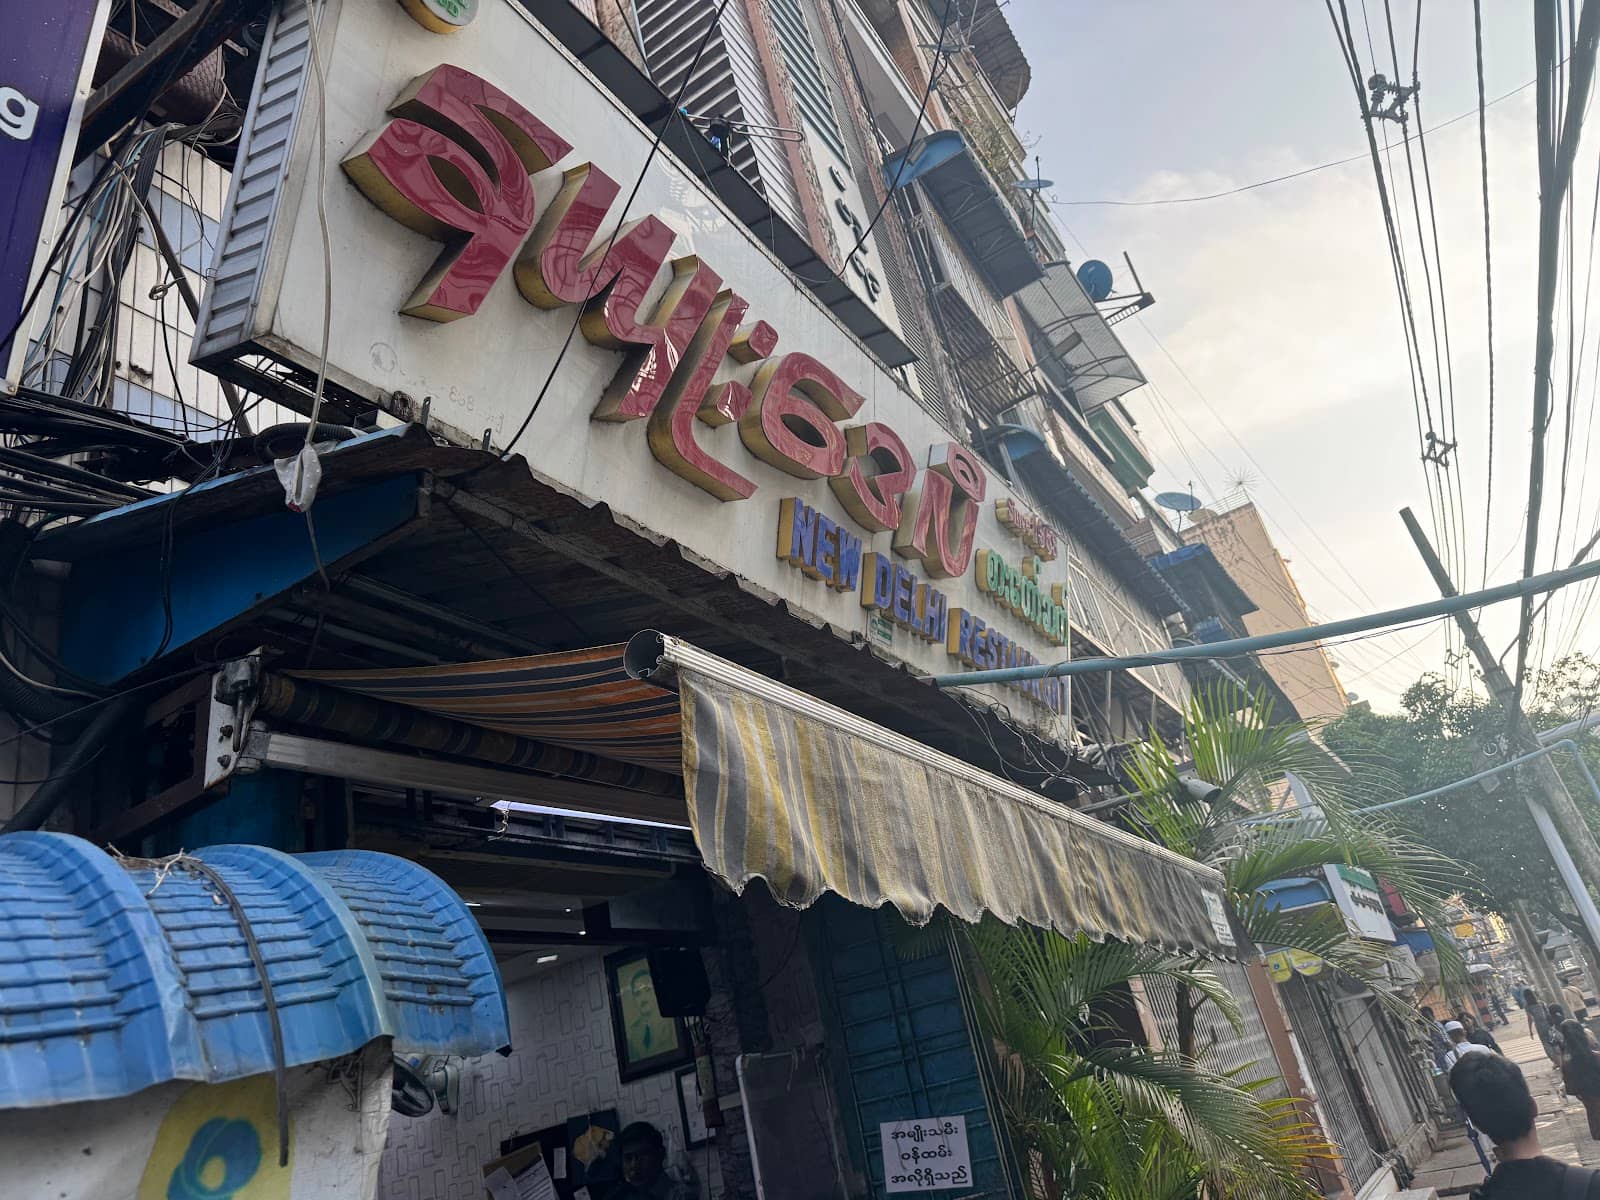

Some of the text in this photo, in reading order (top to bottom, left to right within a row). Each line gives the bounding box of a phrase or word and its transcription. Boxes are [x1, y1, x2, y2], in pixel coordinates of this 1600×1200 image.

[790, 497, 862, 592] NEW
[874, 552, 947, 643] DELHI
[891, 1122, 958, 1142] အမျိုးသမီး
[901, 1144, 952, 1164] ဝန်ထမ်း
[891, 1165, 968, 1187] အလိုရှိသည်
